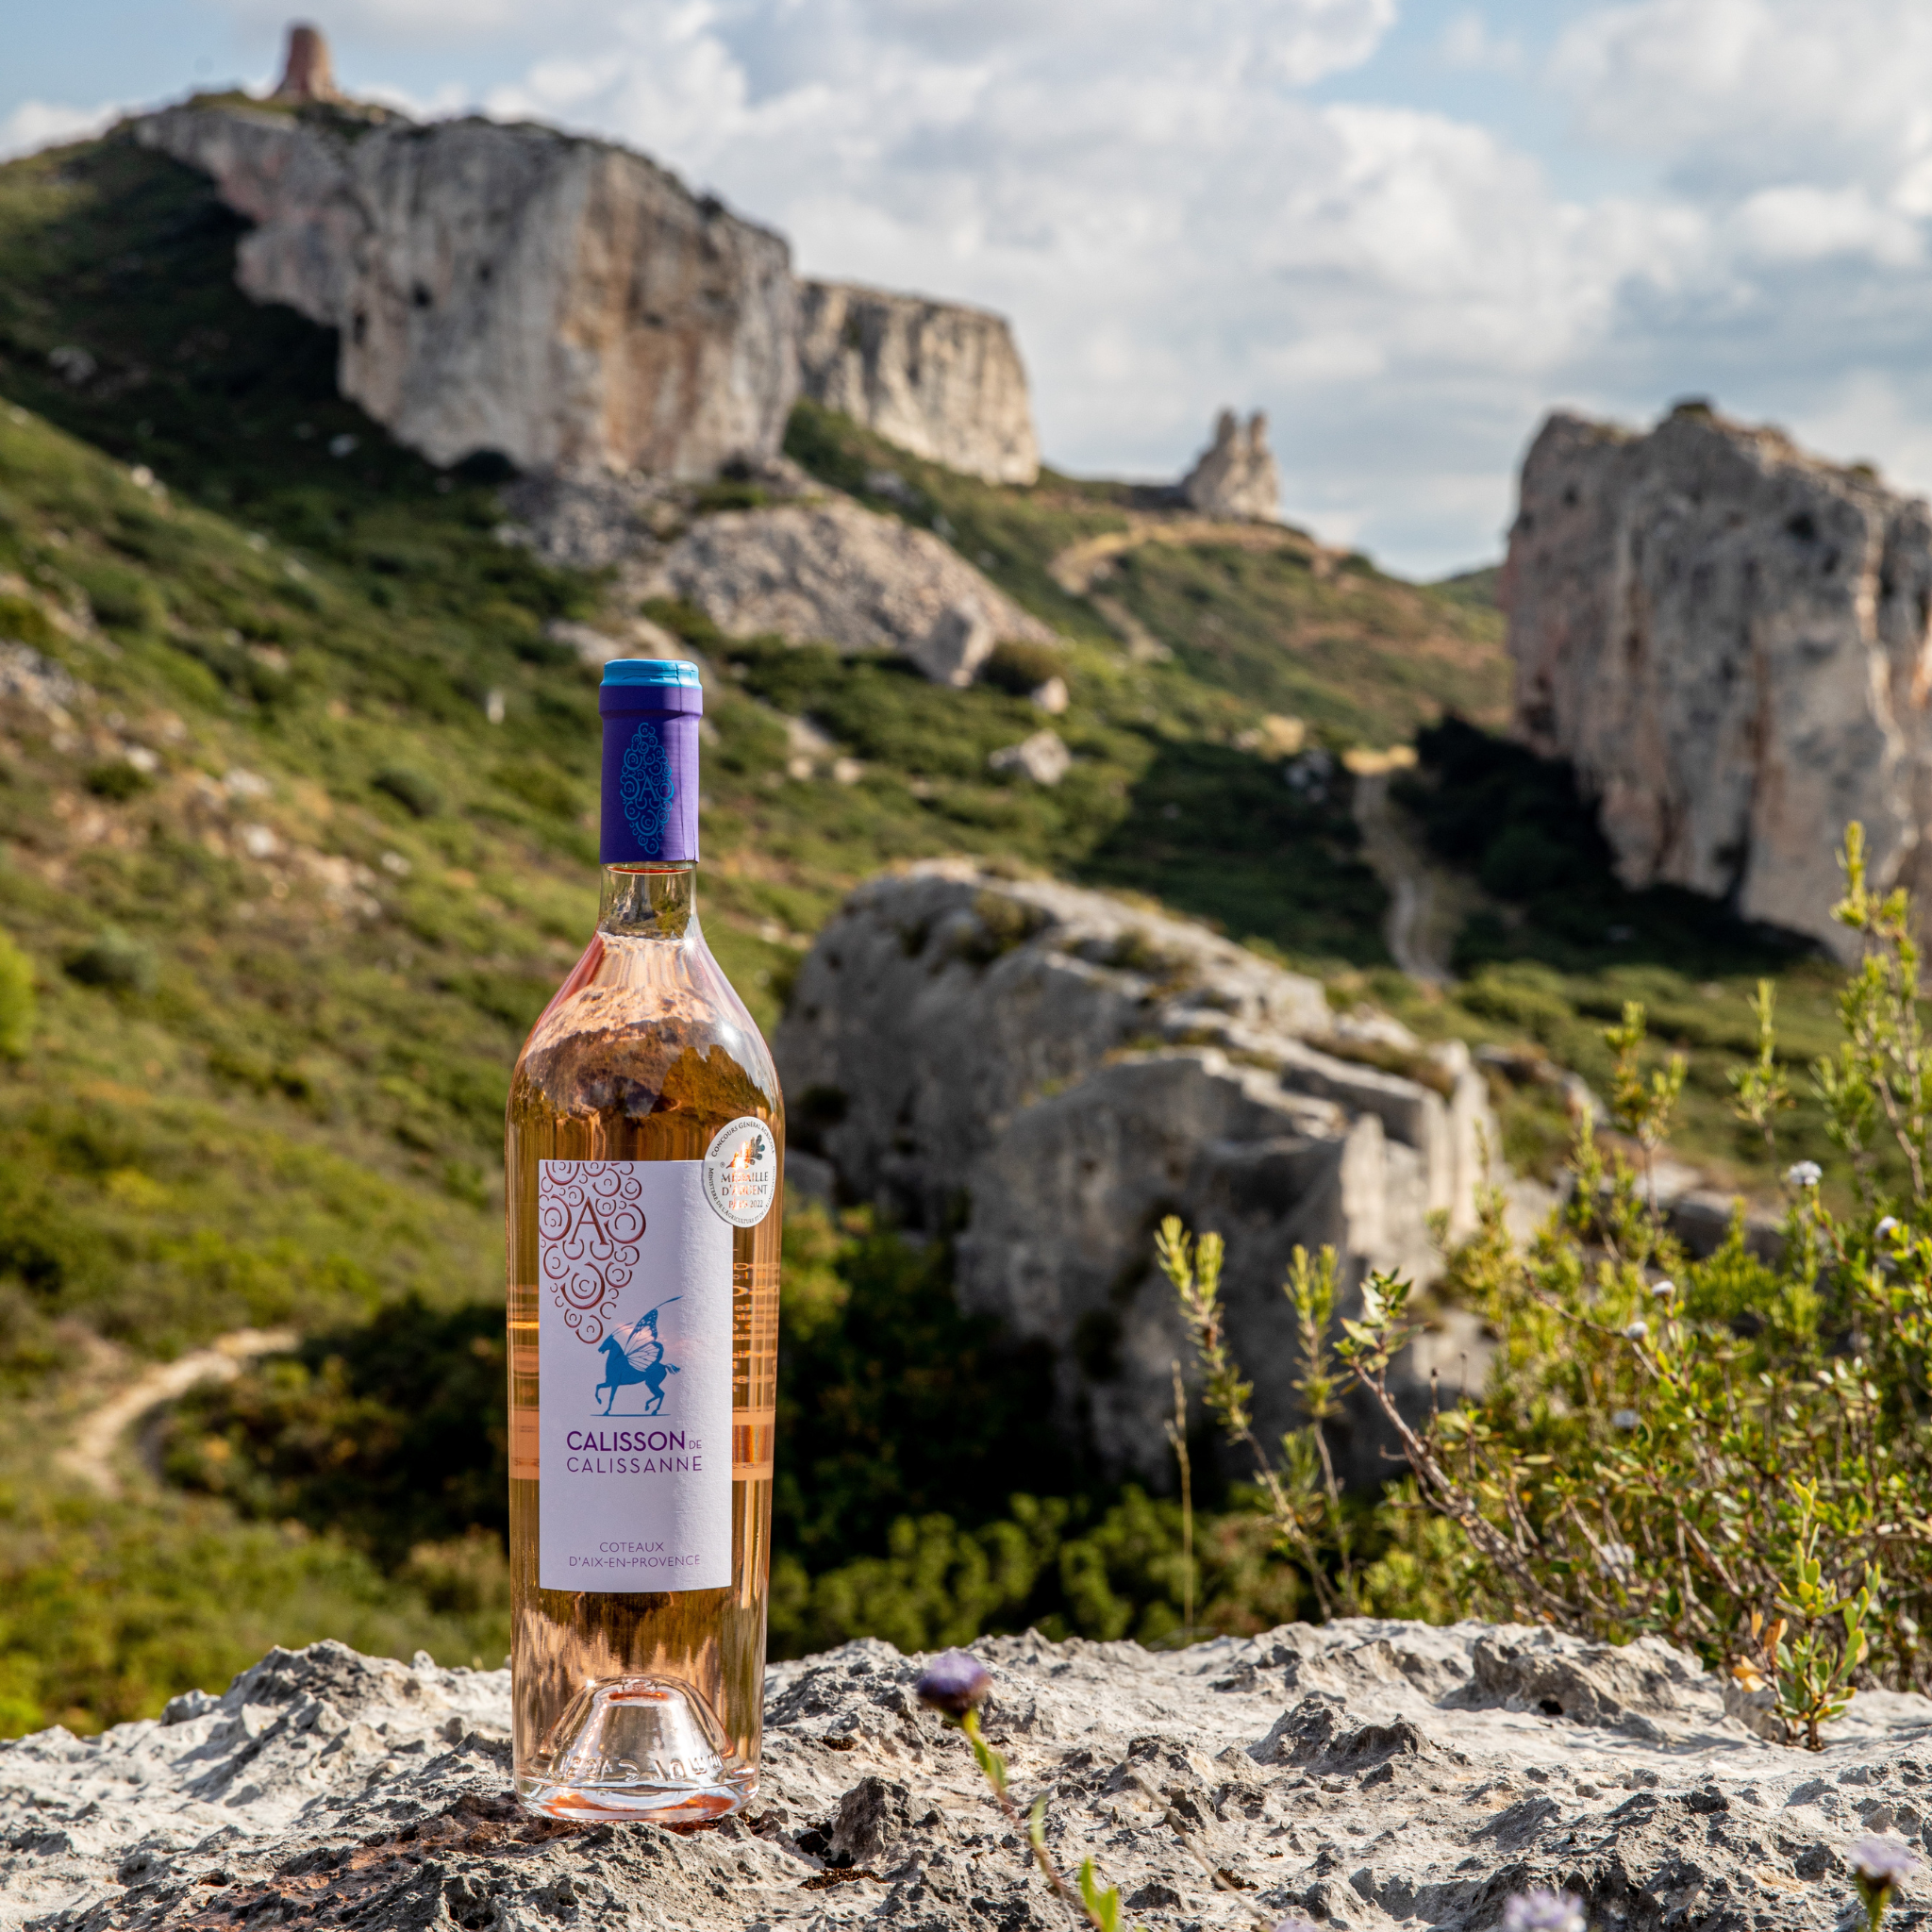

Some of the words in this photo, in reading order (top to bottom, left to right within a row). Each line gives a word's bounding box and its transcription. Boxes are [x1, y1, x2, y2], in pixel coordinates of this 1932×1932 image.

[711, 1124, 739, 1158] CONCOURS
[739, 1120, 761, 1130] GÉNÉRAL
[722, 1184, 769, 1196] D'ARGENT
[749, 1199, 763, 1208] 2022
[566, 1430, 685, 1452] CALISSON
[689, 1440, 702, 1449] DE
[566, 1456, 703, 1474] CALISSANNE
[599, 1541, 664, 1553] COTEAUX
[569, 1555, 701, 1568] D'AIX-EN-PROVENCE
